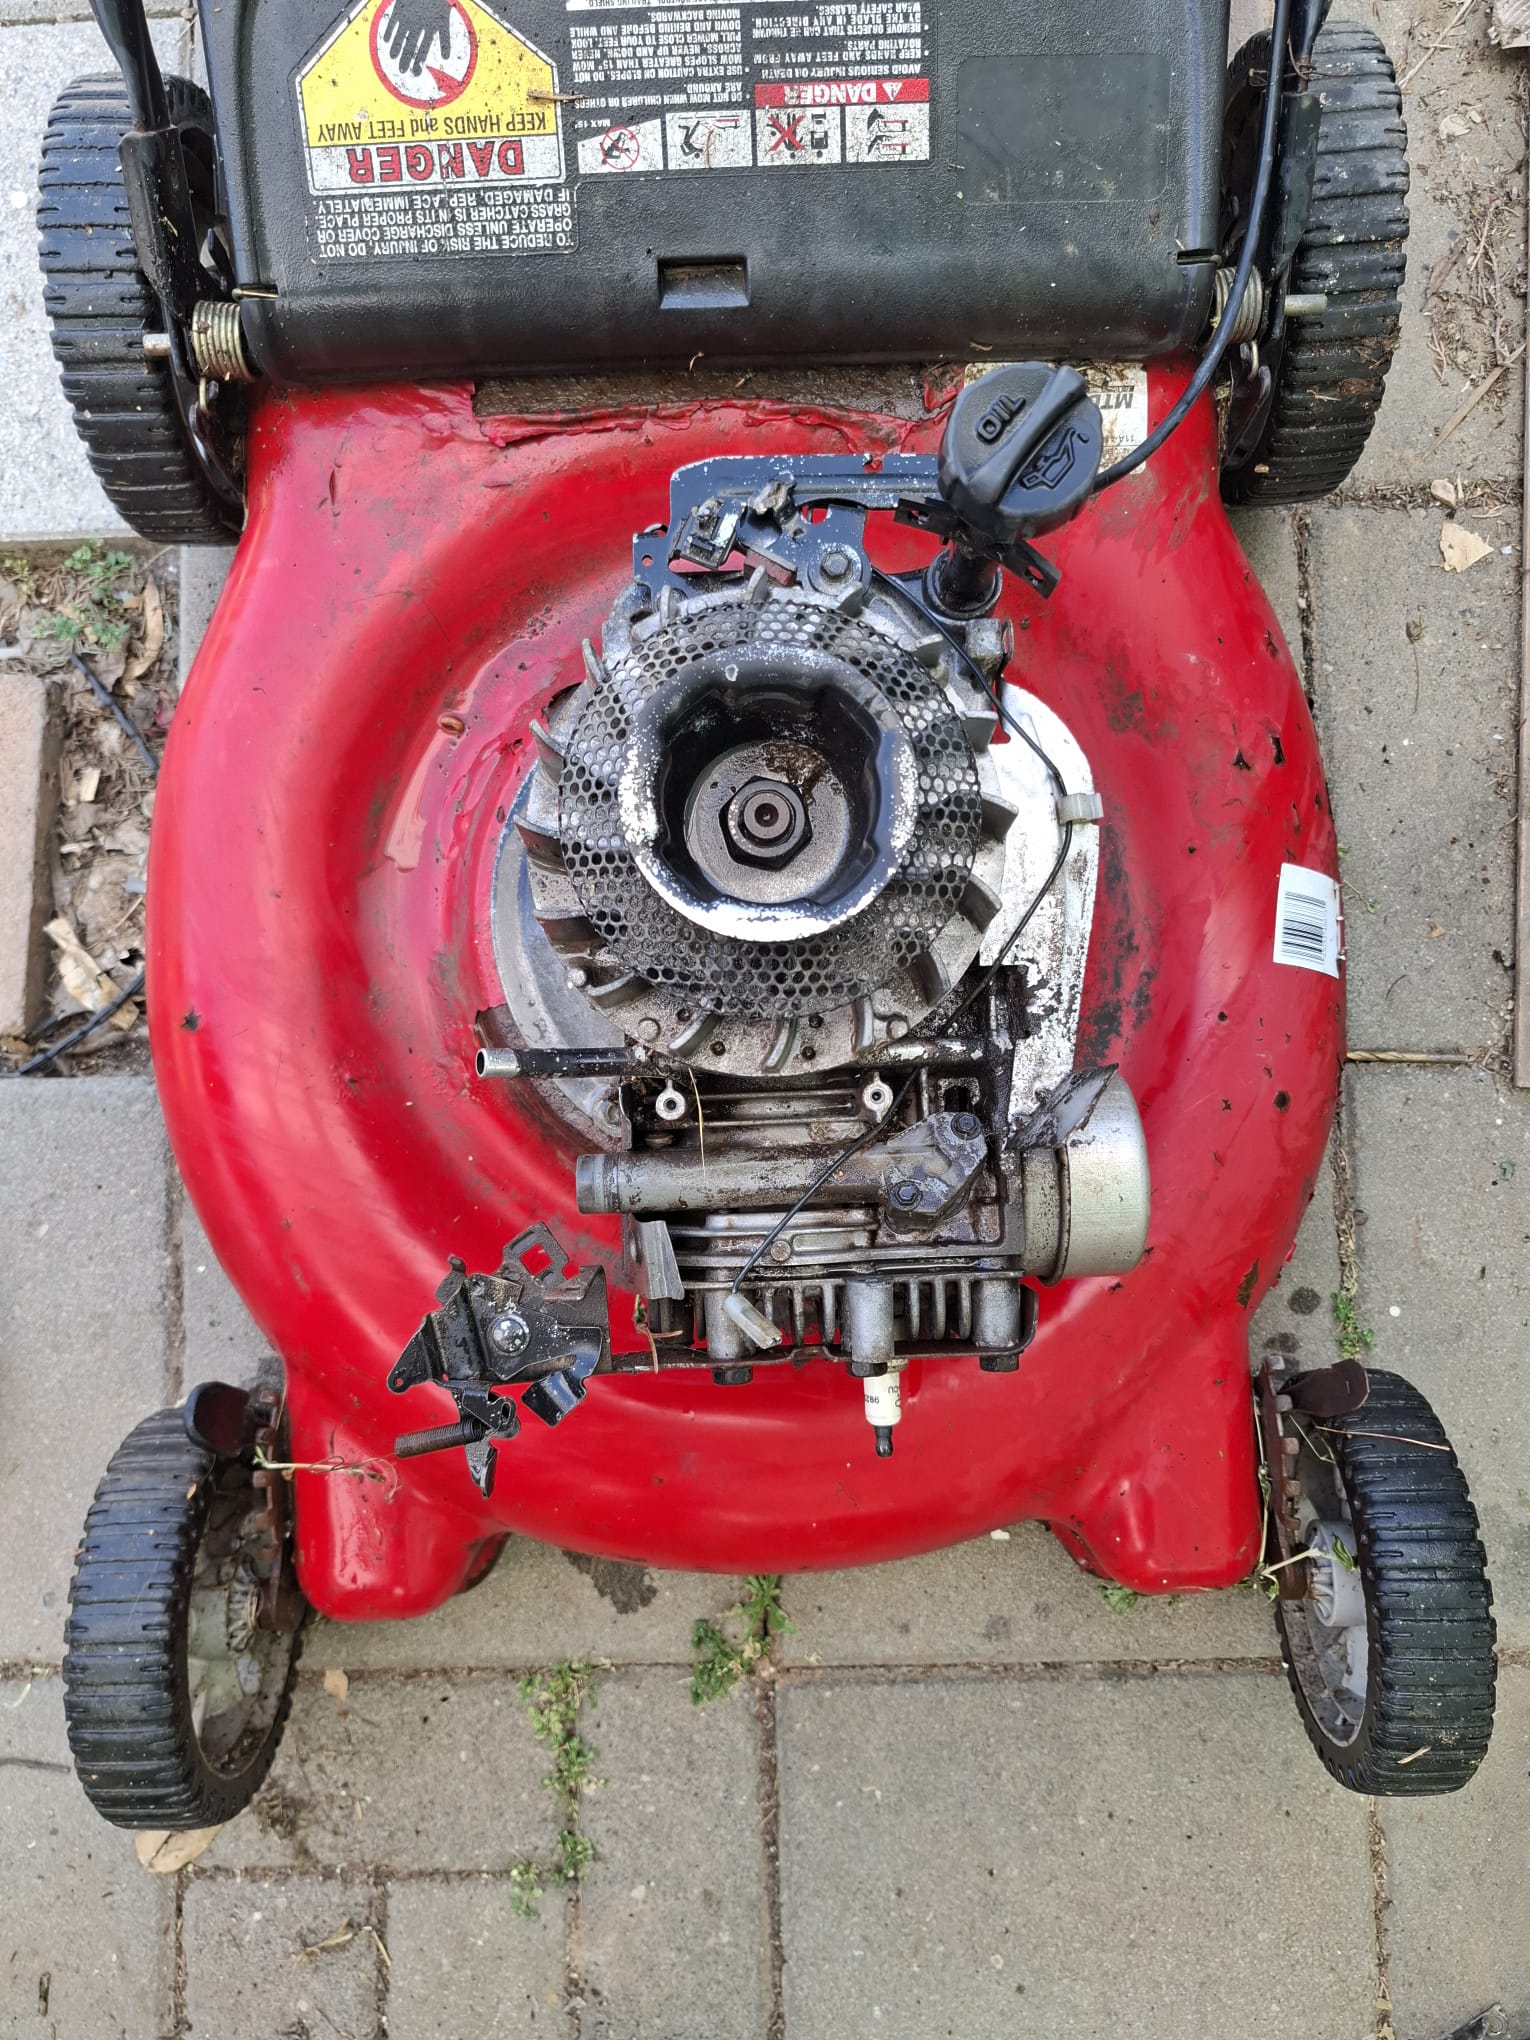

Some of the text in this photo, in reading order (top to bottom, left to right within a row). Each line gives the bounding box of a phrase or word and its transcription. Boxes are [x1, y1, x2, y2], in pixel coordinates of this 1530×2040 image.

[816, 2, 920, 15] WEAR SAFETY GLASSES.
[648, 8, 740, 21] MOVING BACKWARDS.
[850, 14, 881, 24] BLADE
[886, 14, 904, 23] THE
[909, 13, 921, 23] BY
[570, 20, 740, 38] DOWN AND BEHIND BEFORE AND WHILE
[804, 26, 820, 36] CAN
[823, 26, 845, 35] THAT
[886, 23, 921, 33] REMOVE
[620, 36, 643, 46] YOUR
[646, 35, 656, 45] TO
[659, 34, 684, 44] CLOSE
[687, 32, 718, 43] MOWER
[721, 32, 741, 42] PULL
[571, 38, 593, 48] LOOK
[844, 39, 921, 50] ROTATING PARTS.
[636, 46, 653, 57] AND
[657, 46, 669, 56] UP
[672, 44, 700, 55] NEVER
[899, 49, 921, 59] KEEP
[685, 55, 717, 65] SLOPES
[720, 54, 742, 64] MOW
[754, 54, 780, 64] FROM
[785, 52, 811, 62] AWAY
[816, 52, 838, 62] FEET
[843, 51, 861, 61] AND
[573, 60, 594, 71] MOW
[616, 59, 639, 69] THAN
[642, 56, 682, 68] GREATER
[658, 67, 694, 78] CAUTION
[697, 66, 724, 76] EXTRA
[727, 65, 742, 75] USE
[795, 68, 808, 78] OR
[811, 66, 845, 77] INJURY
[848, 65, 889, 76] SERIOUS
[892, 64, 921, 74] AVOID
[574, 72, 590, 83] NOT
[593, 72, 604, 81] DO
[684, 82, 742, 93] ARE AROUND.
[784, 82, 876, 104] DANGER
[575, 92, 742, 108] DO NOT MOW WHEN CHILDREN OR OTHERS
[318, 112, 546, 142] KEEP HANDS and FEET AWAY
[591, 118, 610, 127] MAX
[346, 140, 524, 183] DANGER
[480, 189, 553, 204] DAMAGED,
[558, 188, 569, 201] IF
[313, 196, 409, 214] IMMEDIATELY.
[531, 203, 570, 217] GRASS
[416, 210, 434, 223] ITS
[455, 208, 466, 221] IS
[470, 205, 528, 220] CATCHER
[315, 214, 359, 228] PLACE.
[363, 211, 412, 226] PROPER
[317, 218, 572, 243] OPERATE UNLESS DISCHARGE COVER OR
[422, 240, 437, 252] OF
[474, 236, 498, 250] THE
[502, 234, 552, 248] REDUCE
[319, 244, 345, 257] NOT
[349, 243, 366, 256] DO
[369, 240, 418, 255] INJURY,
[976, 394, 1026, 445] OIL
